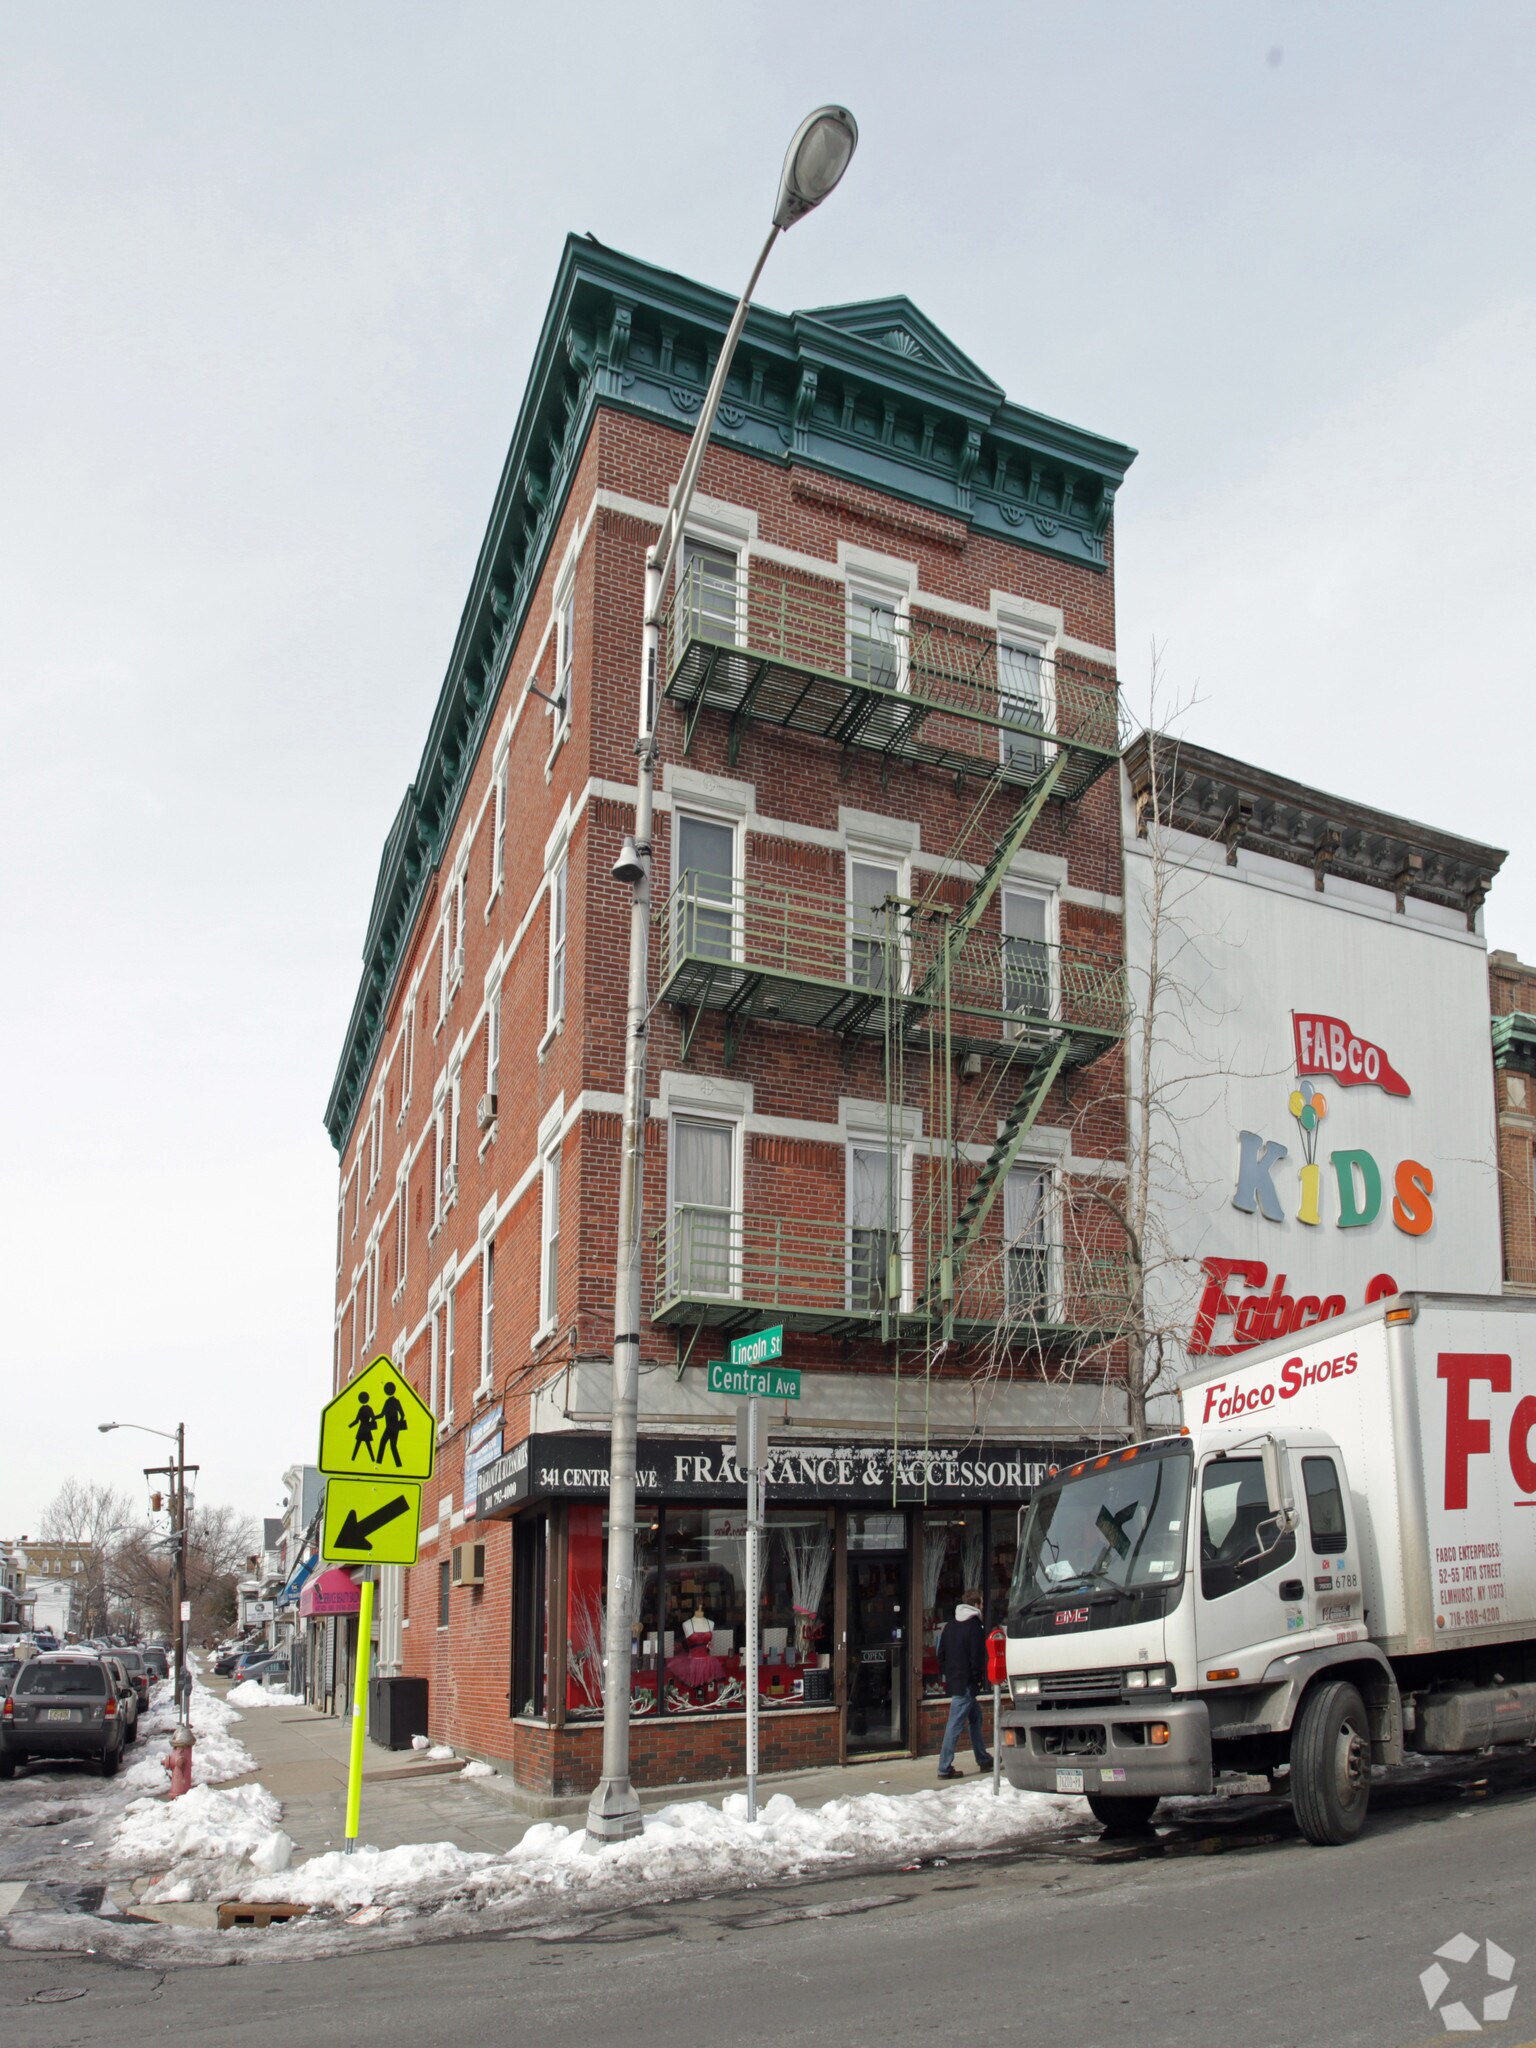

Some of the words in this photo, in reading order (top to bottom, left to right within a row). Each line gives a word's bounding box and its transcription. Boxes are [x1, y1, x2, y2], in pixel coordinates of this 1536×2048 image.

[1299, 1020, 1380, 1080] FABCO
[732, 1337, 767, 1365] Lincoln
[771, 1336, 780, 1354] St
[712, 1366, 771, 1393] Central
[775, 1377, 796, 1395] Ave
[1202, 1382, 1275, 1424] Fabco
[1278, 1352, 1358, 1400] SHOES
[540, 1467, 560, 1487] 341
[563, 1468, 611, 1487] CENTR
[862, 1458, 884, 1486] &
[1436, 1546, 1456, 1562] FABCO
[1459, 1543, 1499, 1560] ENTERPRISES
[1335, 1574, 1357, 1589] 6788
[1439, 1567, 1460, 1584] 52-55
[1462, 1565, 1477, 1582] 74TH
[1479, 1563, 1501, 1580] STREET
[1477, 1585, 1486, 1601] NY
[1488, 1583, 1504, 1600] 11373
[1055, 1607, 1089, 1626] GMC
[1449, 1606, 1500, 1626] 718-898-4200
[863, 1651, 885, 1661] OPEN
